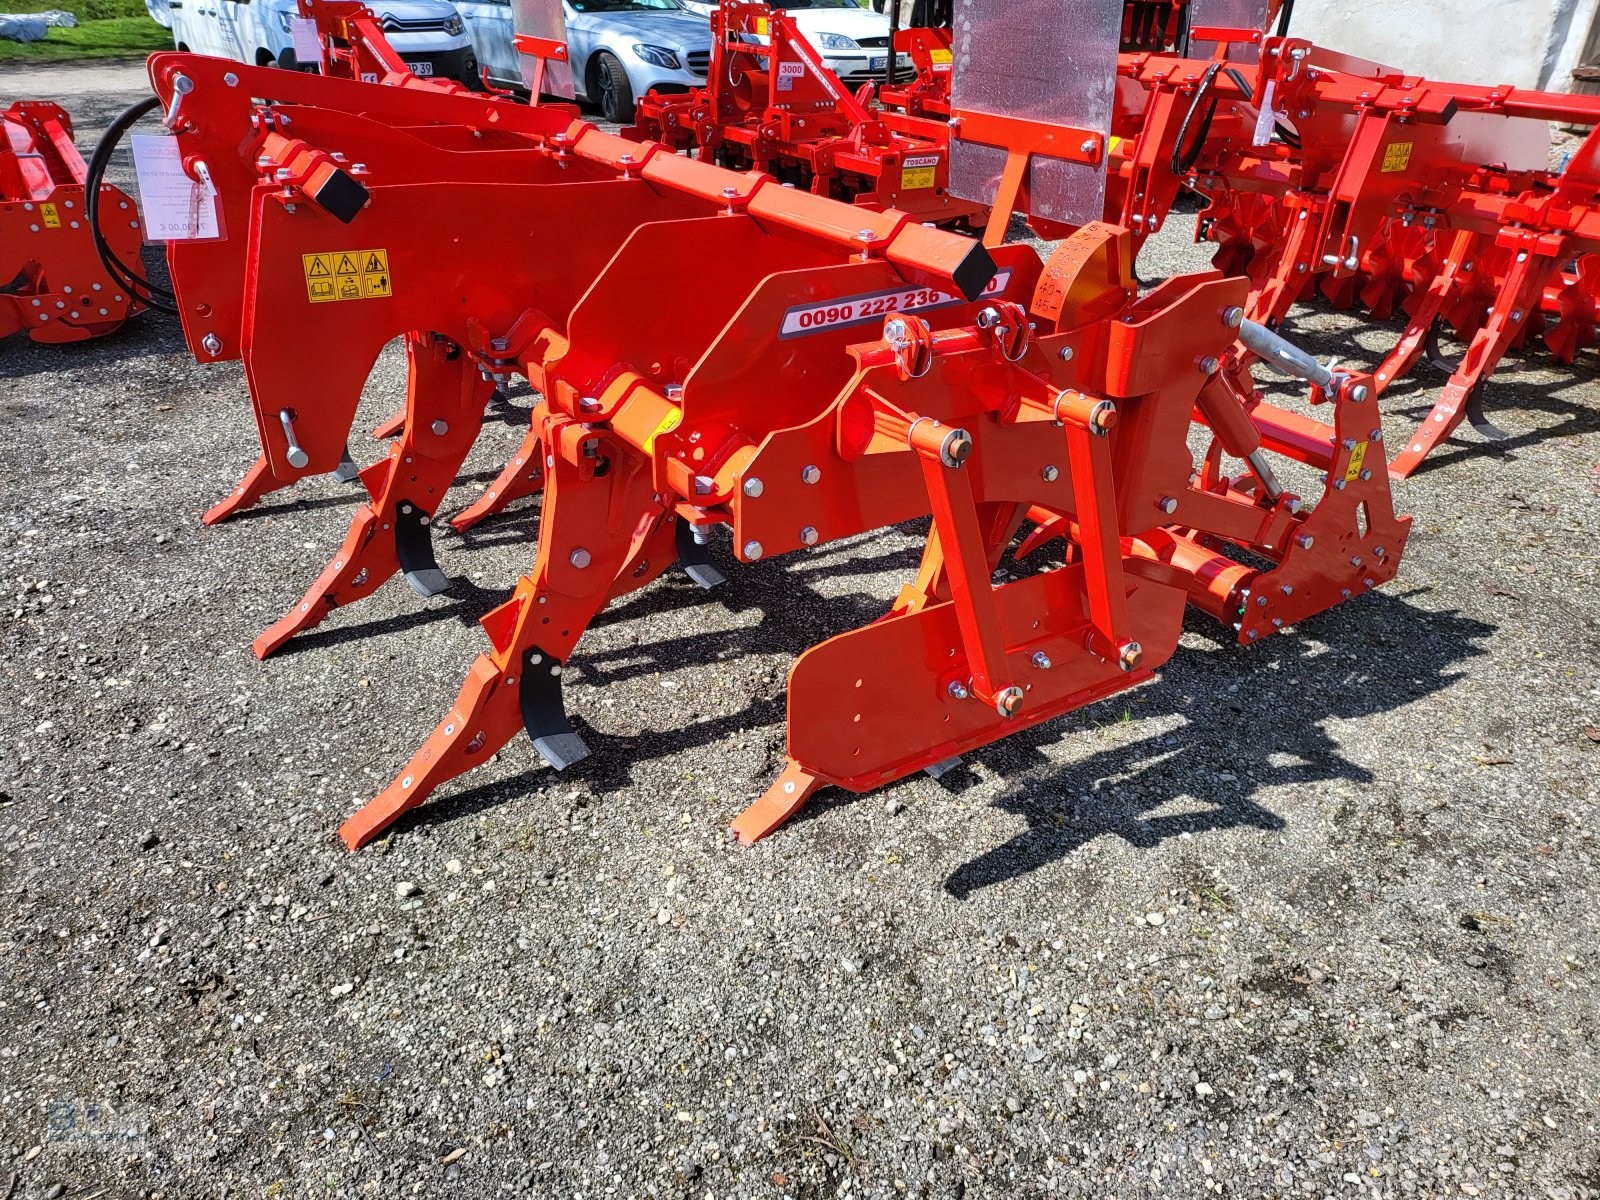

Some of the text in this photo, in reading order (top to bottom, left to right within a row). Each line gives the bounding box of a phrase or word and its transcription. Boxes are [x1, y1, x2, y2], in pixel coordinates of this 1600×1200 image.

[420, 63, 431, 74] 39
[782, 66, 802, 74] 3000
[905, 158, 937, 166] TOSCANO
[799, 305, 853, 328] 0090
[859, 296, 897, 318] 222
[903, 289, 940, 310] 236
